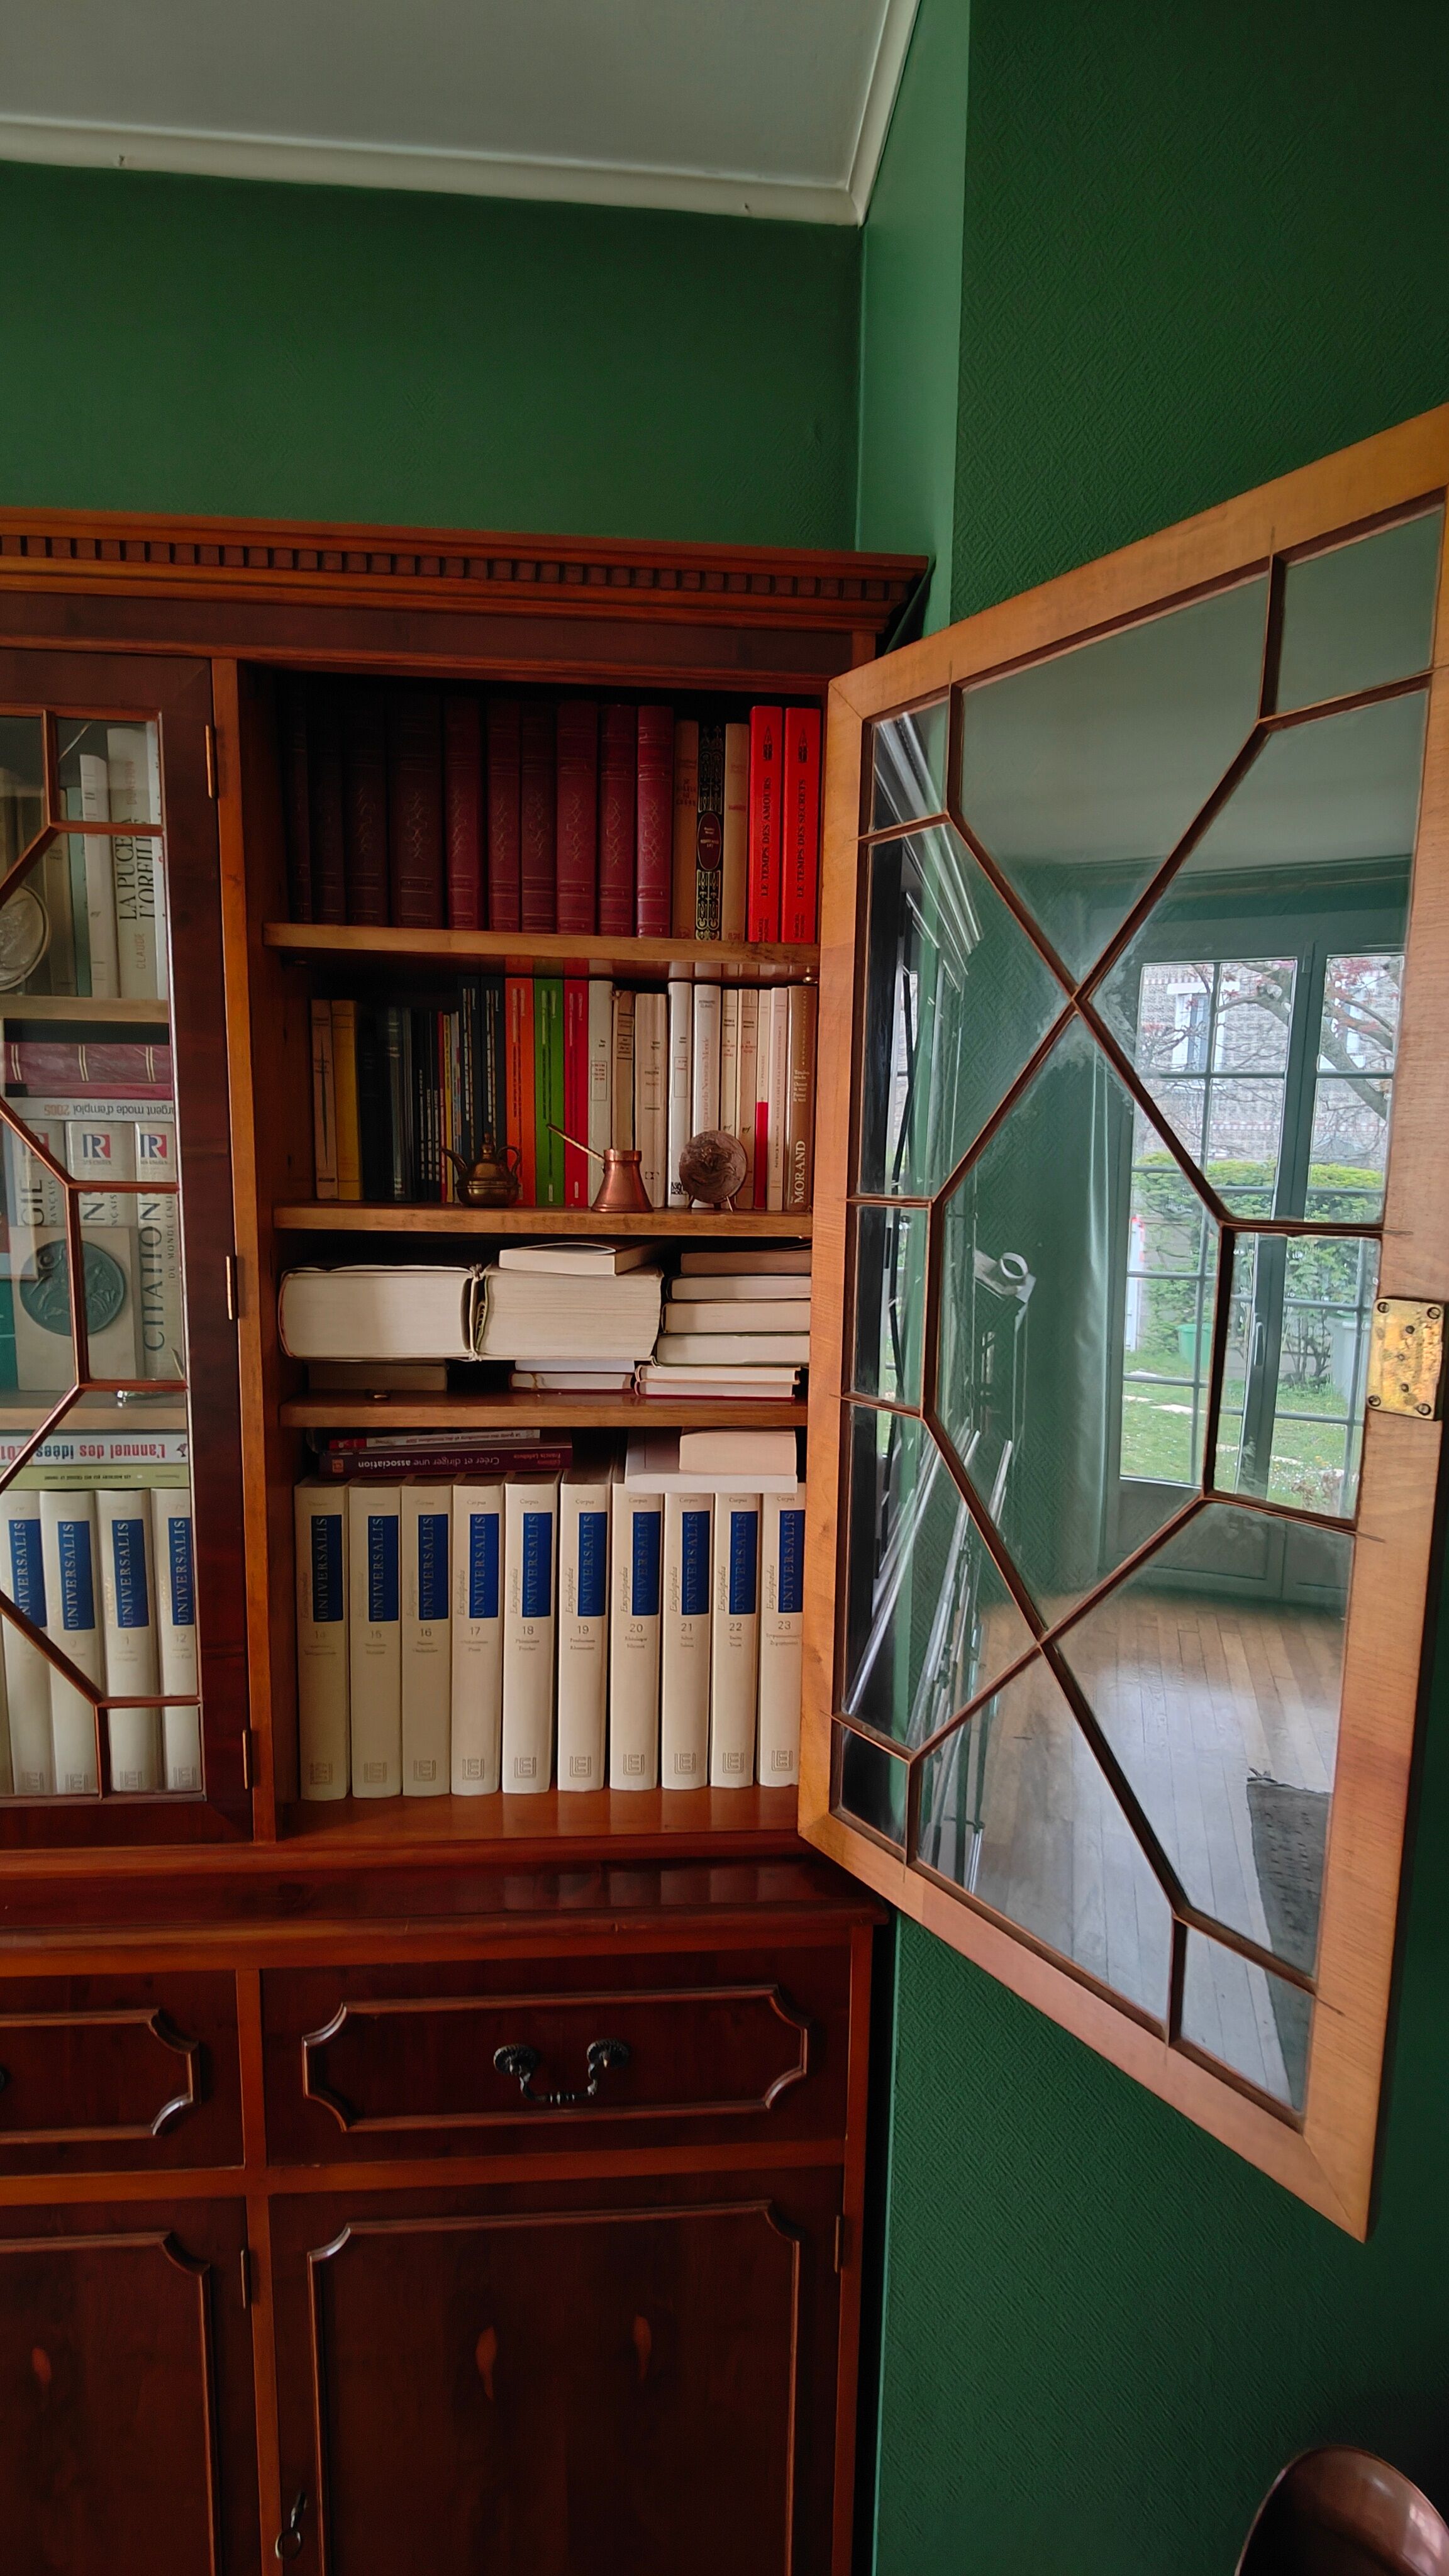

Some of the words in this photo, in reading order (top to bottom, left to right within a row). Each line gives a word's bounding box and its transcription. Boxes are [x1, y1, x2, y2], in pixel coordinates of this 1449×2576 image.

[762, 777, 772, 823] AMOURS
[797, 779, 806, 823] SECRETS
[762, 824, 770, 845] DES
[114, 836, 135, 889] PUCE
[134, 819, 155, 919] L'OREILL
[761, 847, 770, 881] TEMPS
[797, 847, 805, 882] TEMPS
[761, 883, 769, 896] LE
[796, 886, 804, 898] LE
[118, 896, 137, 920] LA
[135, 933, 146, 970] CLAUDE
[73, 1104, 114, 1117] d'emploi
[116, 1106, 144, 1116] mode
[793, 1141, 806, 1204] MORAND
[166, 1194, 175, 1218] ENTI
[167, 1225, 175, 1260] MONDE
[139, 1192, 165, 1352] CITATION
[168, 1266, 175, 1279] DU
[35, 1445, 74, 1460] idées
[79, 1445, 104, 1459] des
[110, 1444, 166, 1460] L'annuel
[358, 1460, 411, 1470] association
[433, 1455, 461, 1467] diriger
[464, 1457, 473, 1465] et
[476, 1457, 500, 1465] Créer
[14, 1522, 31, 1615] NIVERSALIS
[63, 1523, 79, 1628] UNIVERSALIS
[117, 1522, 133, 1626] UNIVERSALIS
[174, 1520, 189, 1624] UNIVERSALIS
[317, 1518, 329, 1620] UNIVERSALIS
[372, 1518, 384, 1619] UNIVERSALIS
[423, 1518, 433, 1618] UNIVERSALIS
[474, 1516, 486, 1616] UNIVERSALIS
[527, 1515, 538, 1615] UNIVERSALIS
[582, 1515, 594, 1615] UNIVERSALIS
[636, 1513, 648, 1614] UNIVERSALIS
[686, 1513, 698, 1613] UNIVERSALIS
[735, 1513, 747, 1613] UNIVERSALIS
[782, 1513, 795, 1611] UNIVERSALIS
[419, 1628, 431, 1636] 16
[470, 1626, 480, 1635] 17
[522, 1626, 534, 1635] 18
[578, 1625, 589, 1634] 19
[630, 1623, 643, 1632] 20
[680, 1623, 692, 1631] 21
[729, 1622, 743, 1631] 22
[778, 1621, 791, 1630] 23
